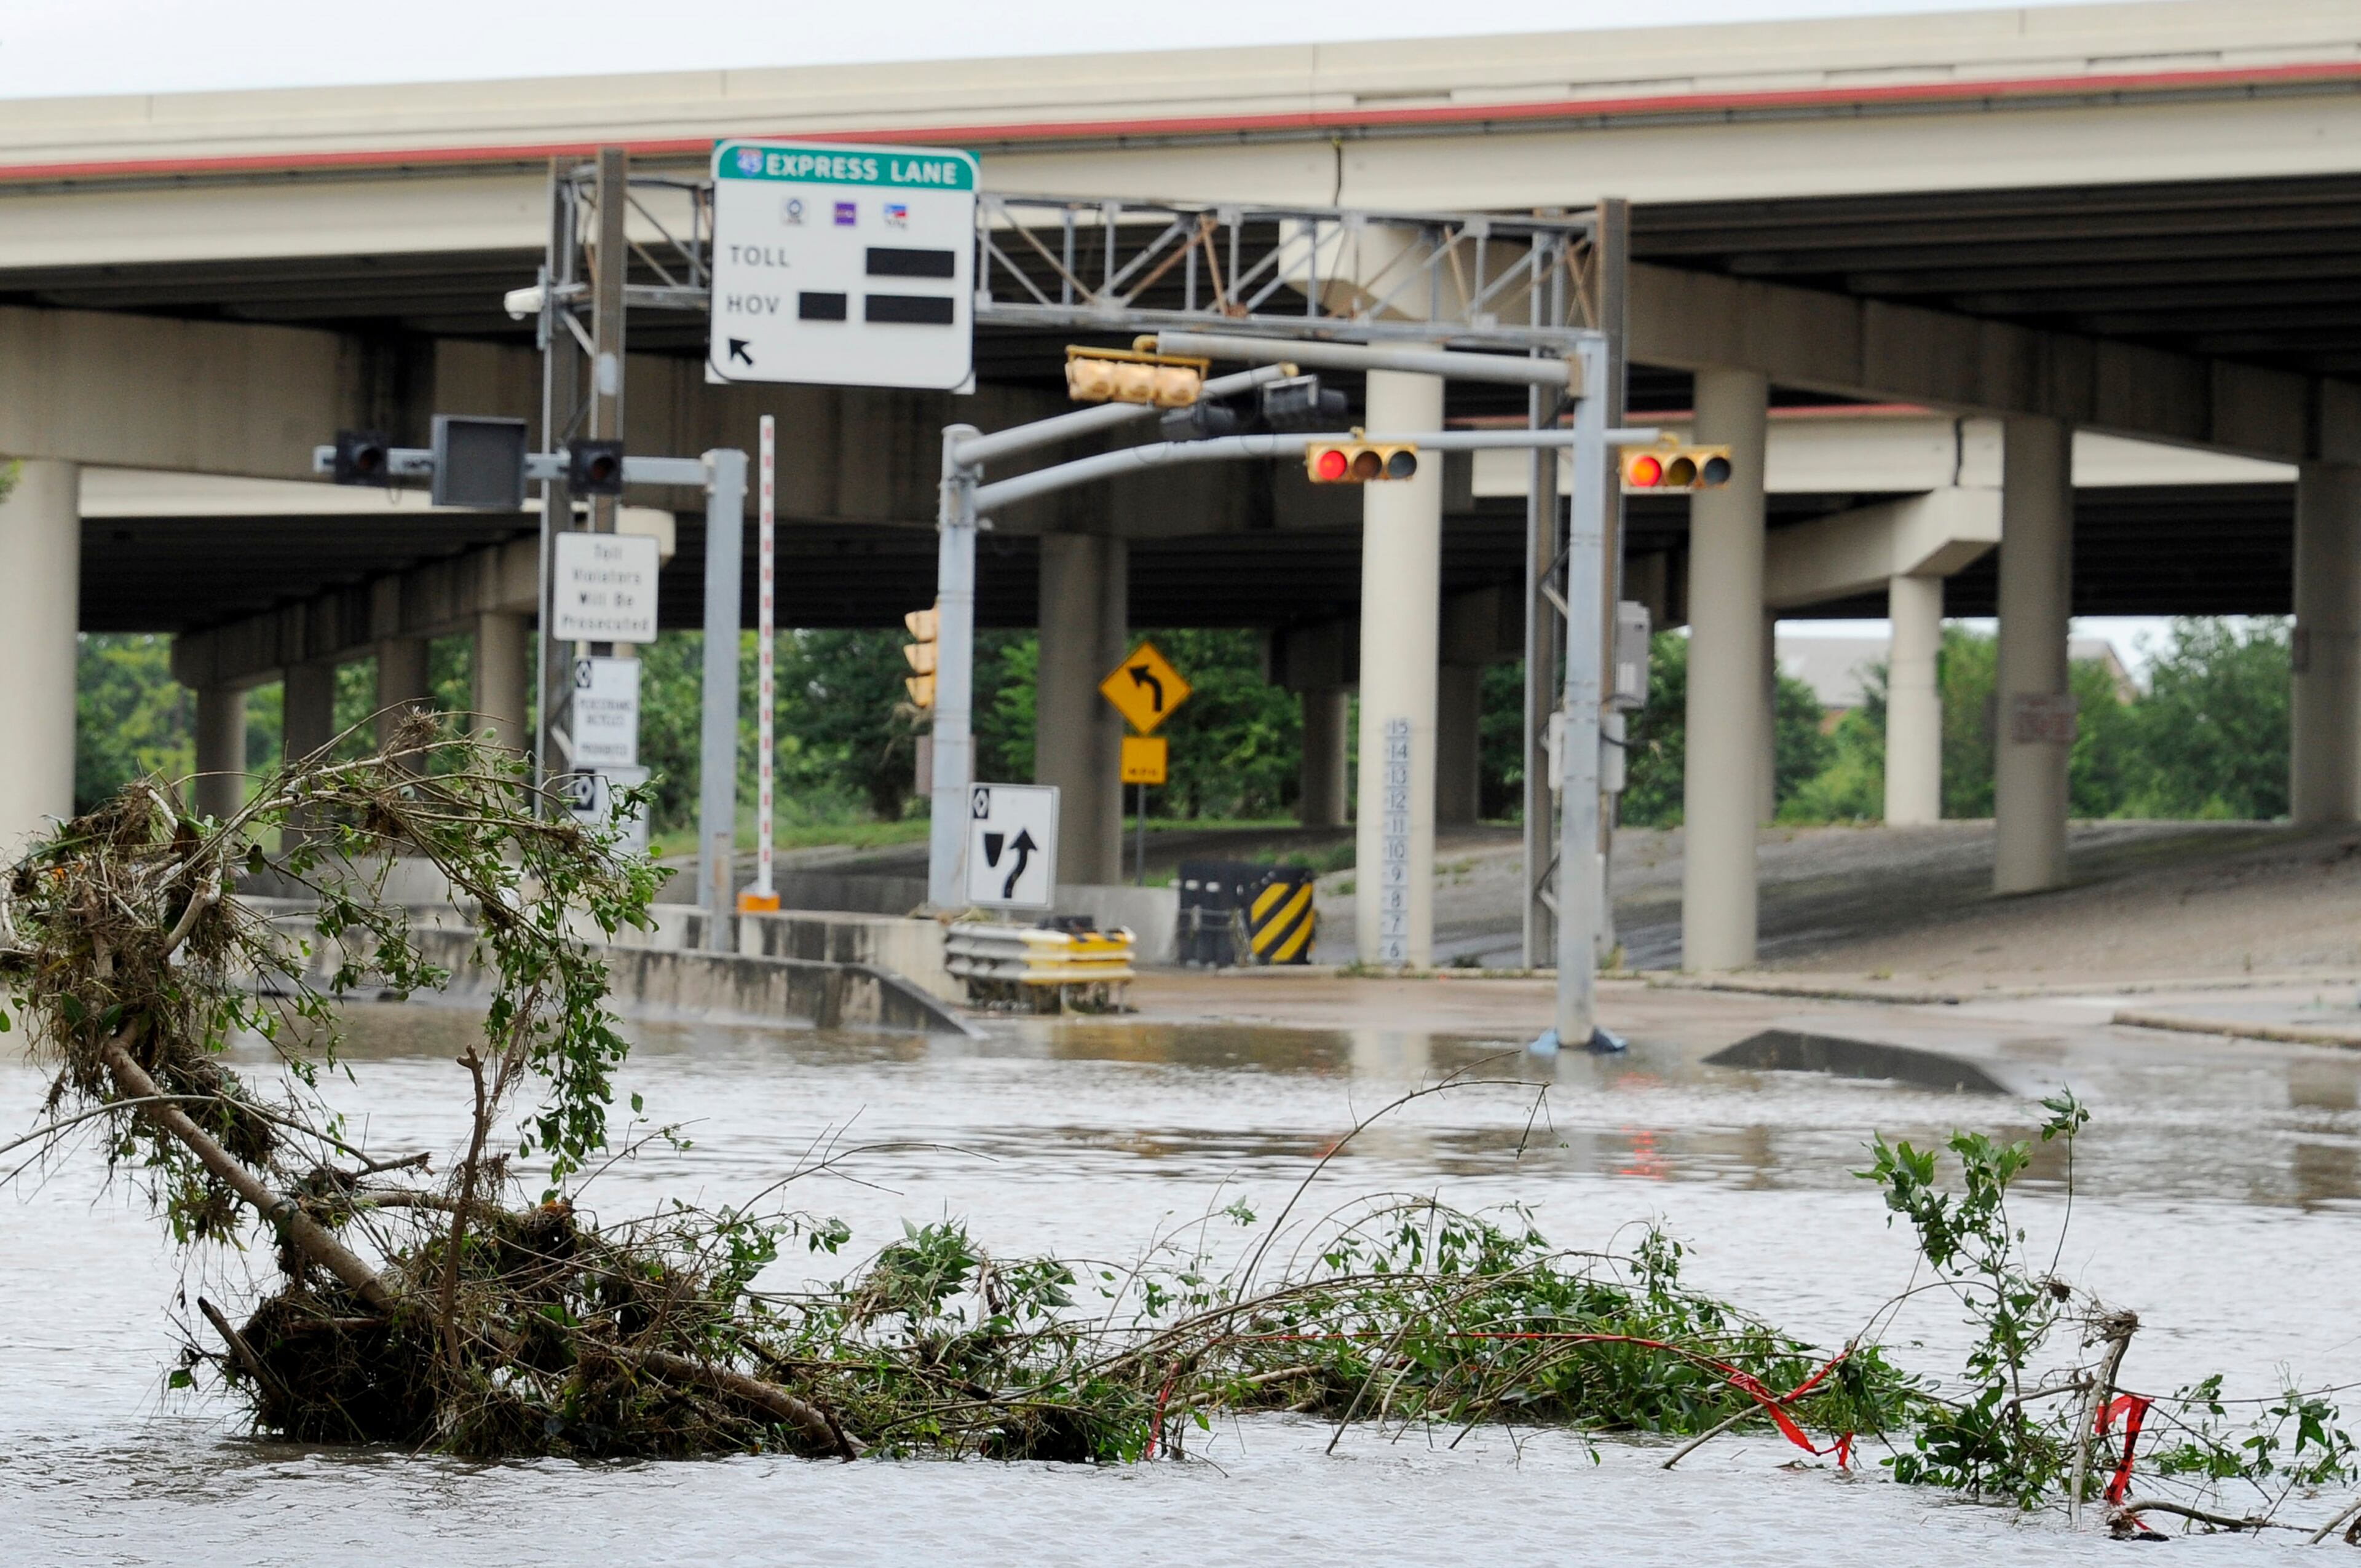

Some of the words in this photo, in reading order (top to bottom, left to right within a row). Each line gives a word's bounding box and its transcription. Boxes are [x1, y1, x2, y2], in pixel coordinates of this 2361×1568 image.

[766, 154, 877, 181] EXPRESS
[890, 160, 957, 185] LANE
[731, 246, 789, 266] TOLL
[727, 296, 780, 314] HOV
[1391, 719, 1409, 735] 15
[1390, 743, 1407, 760] 14
[1390, 768, 1406, 784] 13
[1390, 793, 1406, 810] 12
[1391, 818, 1404, 833] 11
[1388, 843, 1405, 859] 10
[1392, 866, 1402, 881] 9
[1390, 891, 1401, 908] 8
[1391, 917, 1399, 933] 7
[1389, 941, 1400, 958] 6
